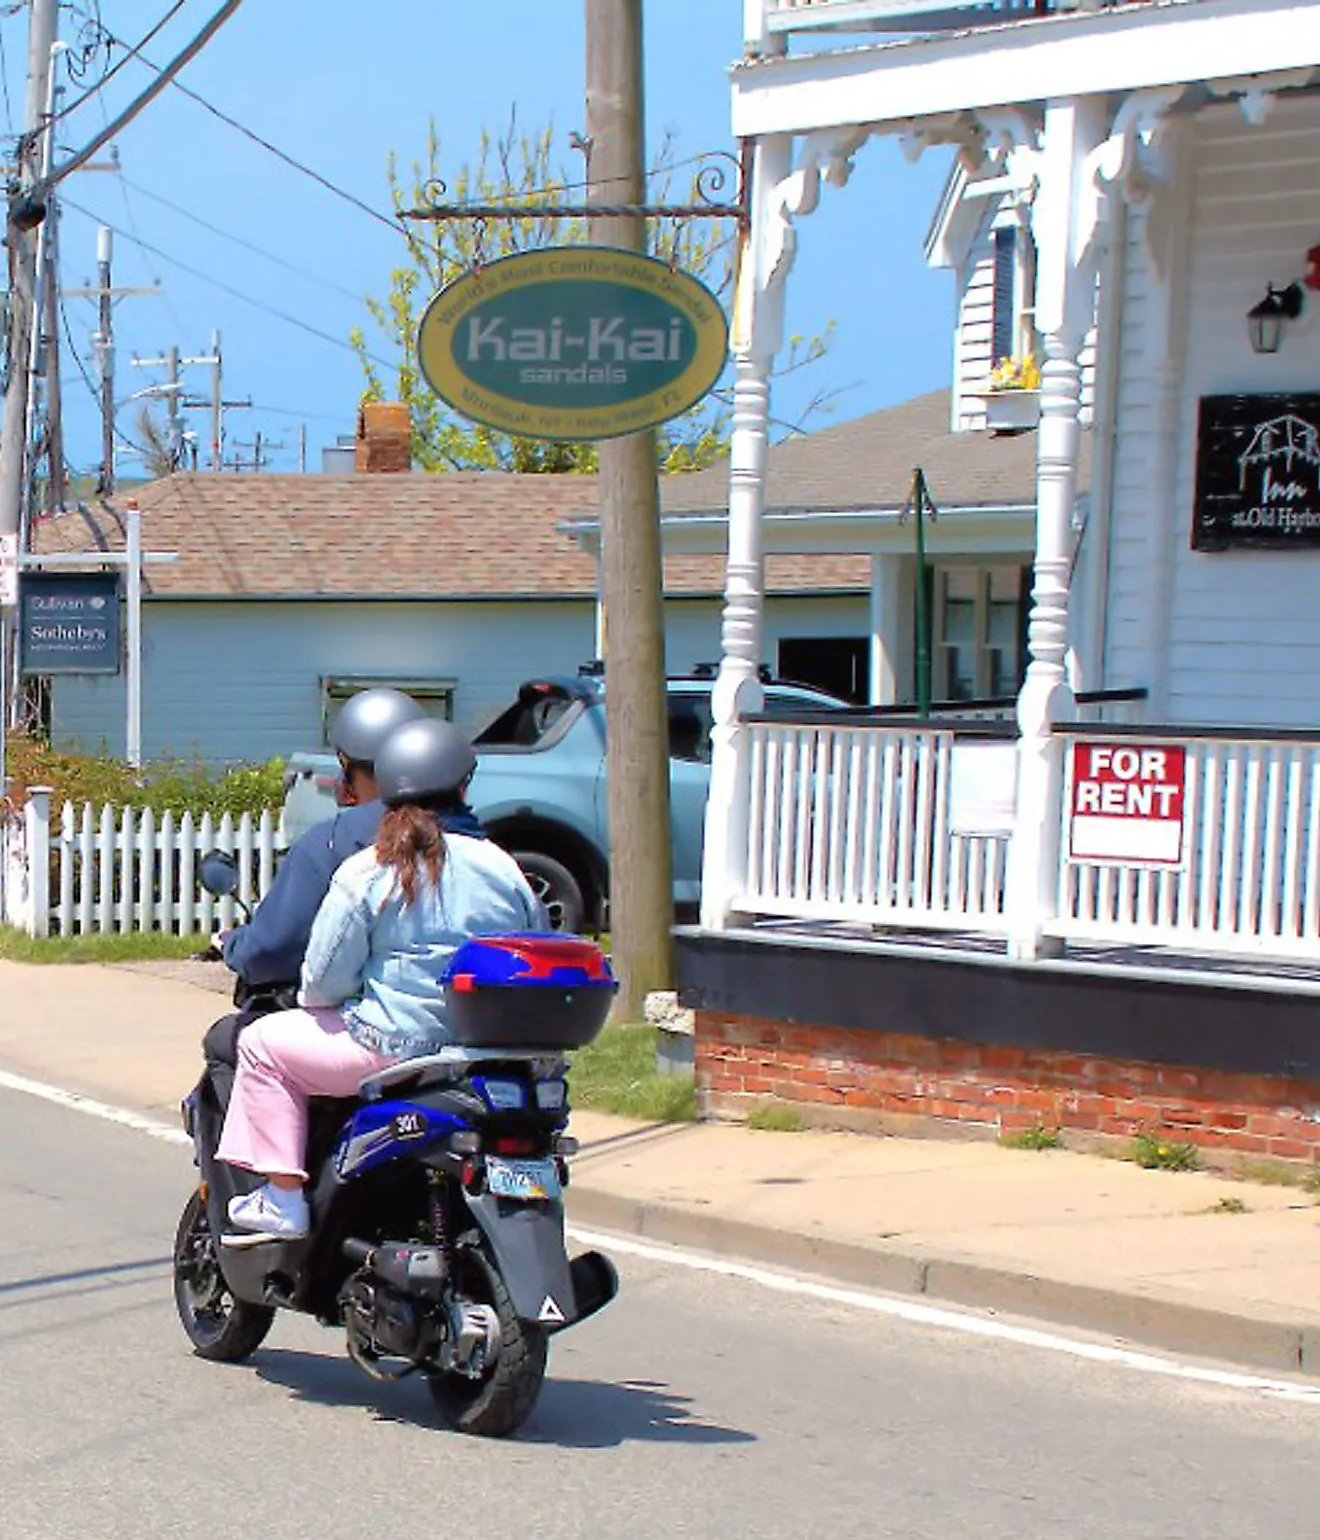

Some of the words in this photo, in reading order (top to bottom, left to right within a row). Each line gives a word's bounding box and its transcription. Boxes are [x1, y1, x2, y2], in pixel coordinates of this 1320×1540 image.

[548, 258, 655, 286] Comfortable
[467, 316, 682, 361] Kai-Kai
[519, 363, 628, 385] sandals
[1261, 466, 1307, 504] Inn
[1248, 507, 1276, 526] Old
[30, 625, 106, 642] Sotheby's
[1089, 747, 1167, 781] FOR
[1076, 780, 1179, 817] RENT
[395, 1114, 420, 1133] 301
